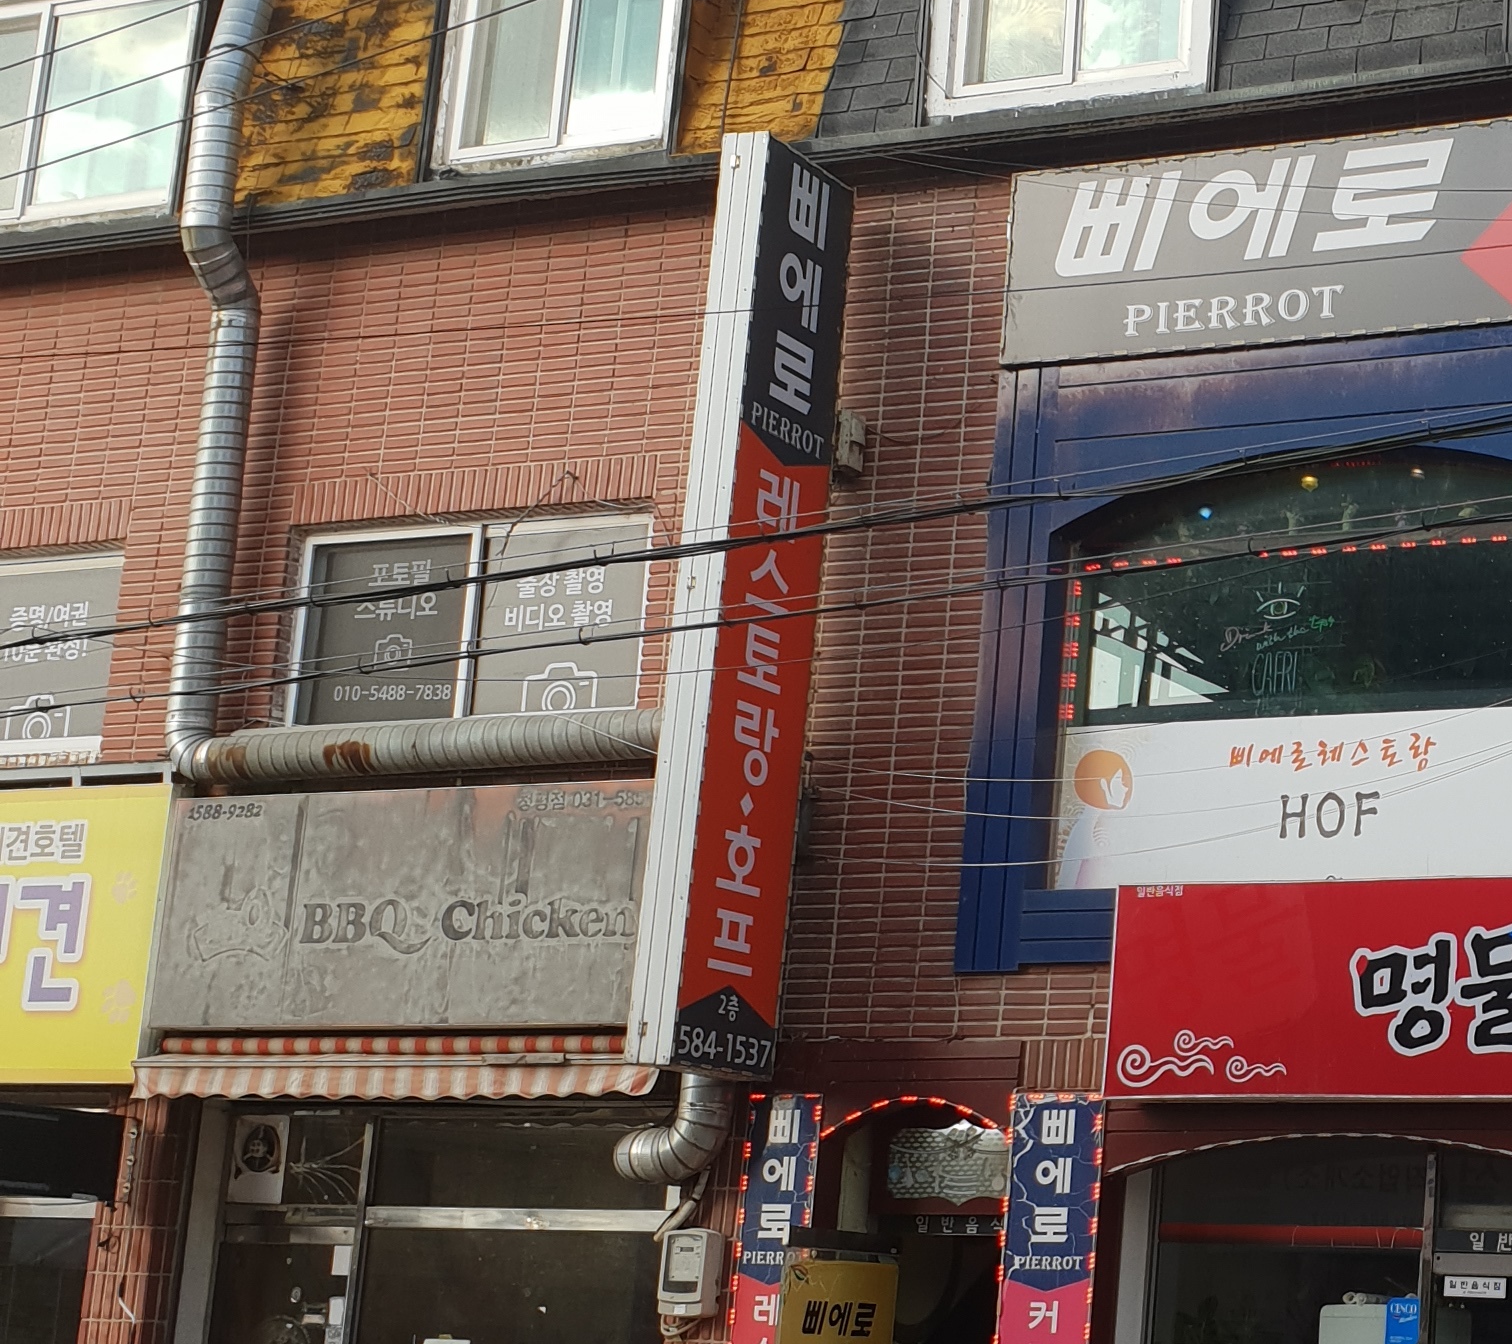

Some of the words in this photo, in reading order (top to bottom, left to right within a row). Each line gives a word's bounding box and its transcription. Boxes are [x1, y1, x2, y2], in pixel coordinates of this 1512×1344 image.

[1055, 138, 1453, 277] 삐에로
[769, 161, 830, 416] 삐에로
[1123, 285, 1344, 337] PIERROT
[751, 402, 824, 460] PIERROT
[368, 559, 432, 586] 포토필
[564, 566, 606, 595] 촬영
[354, 592, 438, 621] 스튜디오
[504, 603, 566, 632] 비디오
[571, 599, 613, 628] 촬영
[334, 684, 451, 701] 010-5488-7838
[187, 802, 262, 820] 1588-9282
[1279, 791, 1380, 839] HOF
[1136, 885, 1184, 898] 일반음식점
[301, 899, 431, 955] BBQ
[441, 897, 636, 941] Chicken
[718, 994, 740, 1022] 2층
[677, 1025, 772, 1068] 584-1537
[758, 1109, 800, 1245] 삐에로
[1031, 1109, 1076, 1243] 삐에로
[1014, 1255, 1083, 1270] PIERROT
[801, 1300, 877, 1337] 삐에로
